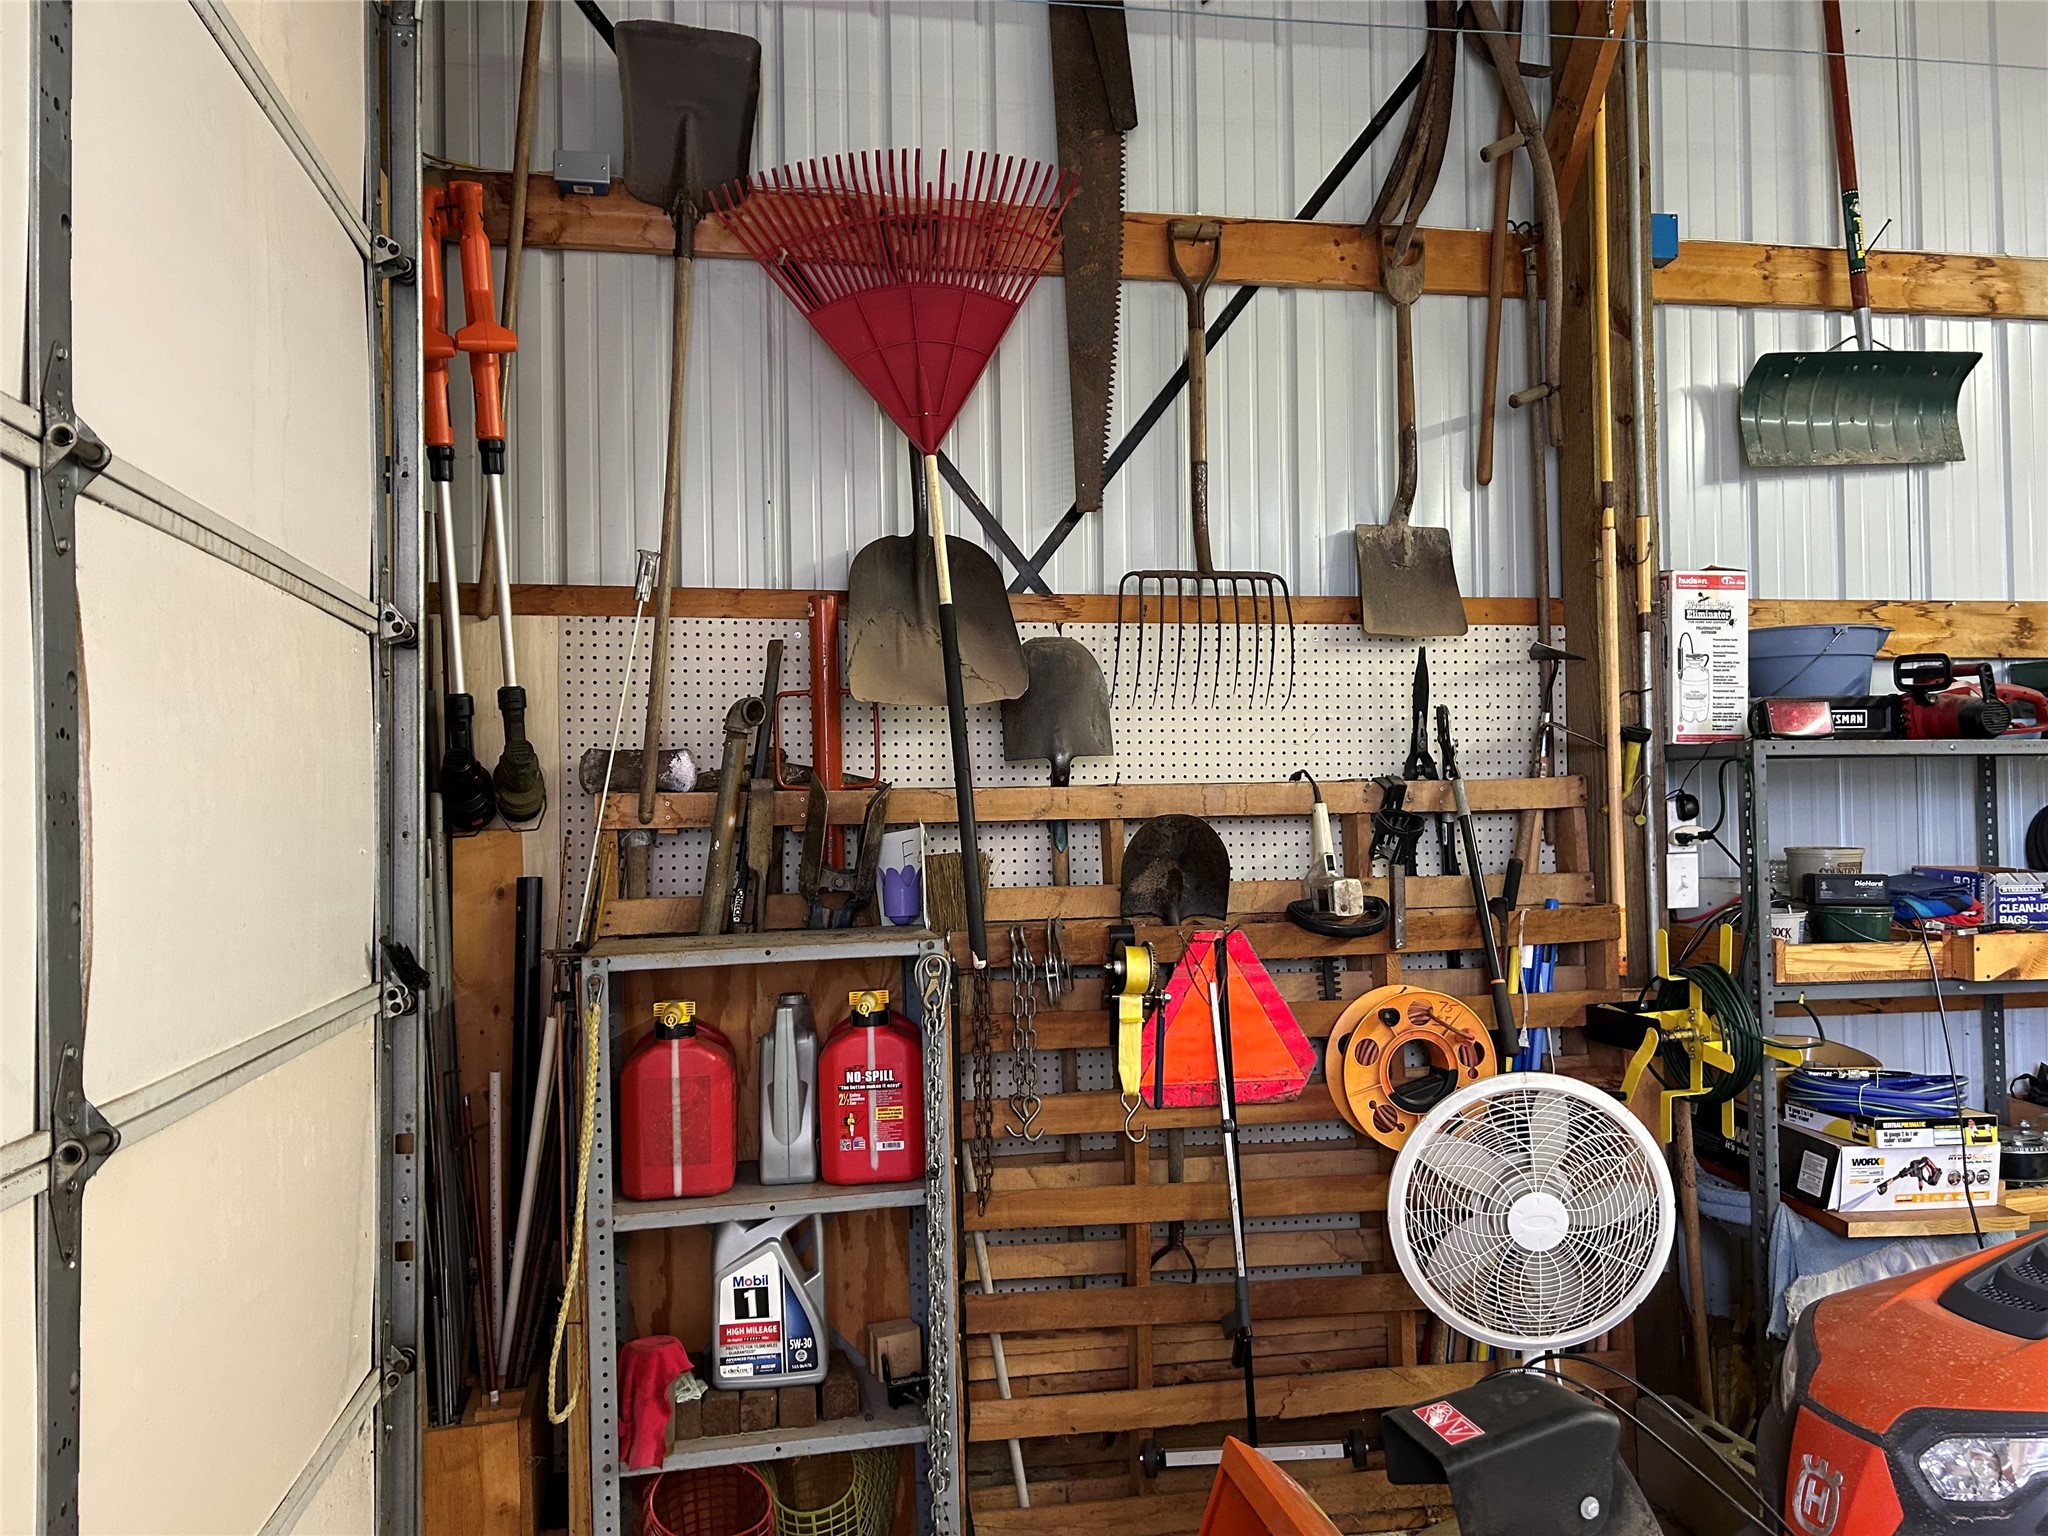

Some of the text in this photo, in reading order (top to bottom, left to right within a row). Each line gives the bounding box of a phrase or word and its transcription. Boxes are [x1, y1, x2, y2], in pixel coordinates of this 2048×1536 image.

[1686, 610, 1731, 620] Eliminator
[1999, 903, 2048, 914] CLEAN-UP
[1999, 915, 2028, 924] BAGS
[846, 1069, 895, 1083] NO-SPILL
[1852, 1157, 1880, 1166] WORX
[733, 1274, 768, 1288] Mobil
[743, 1289, 758, 1318] 1
[726, 1325, 777, 1336] HIGH MILEAGE
[789, 1337, 813, 1350] 5W-30
